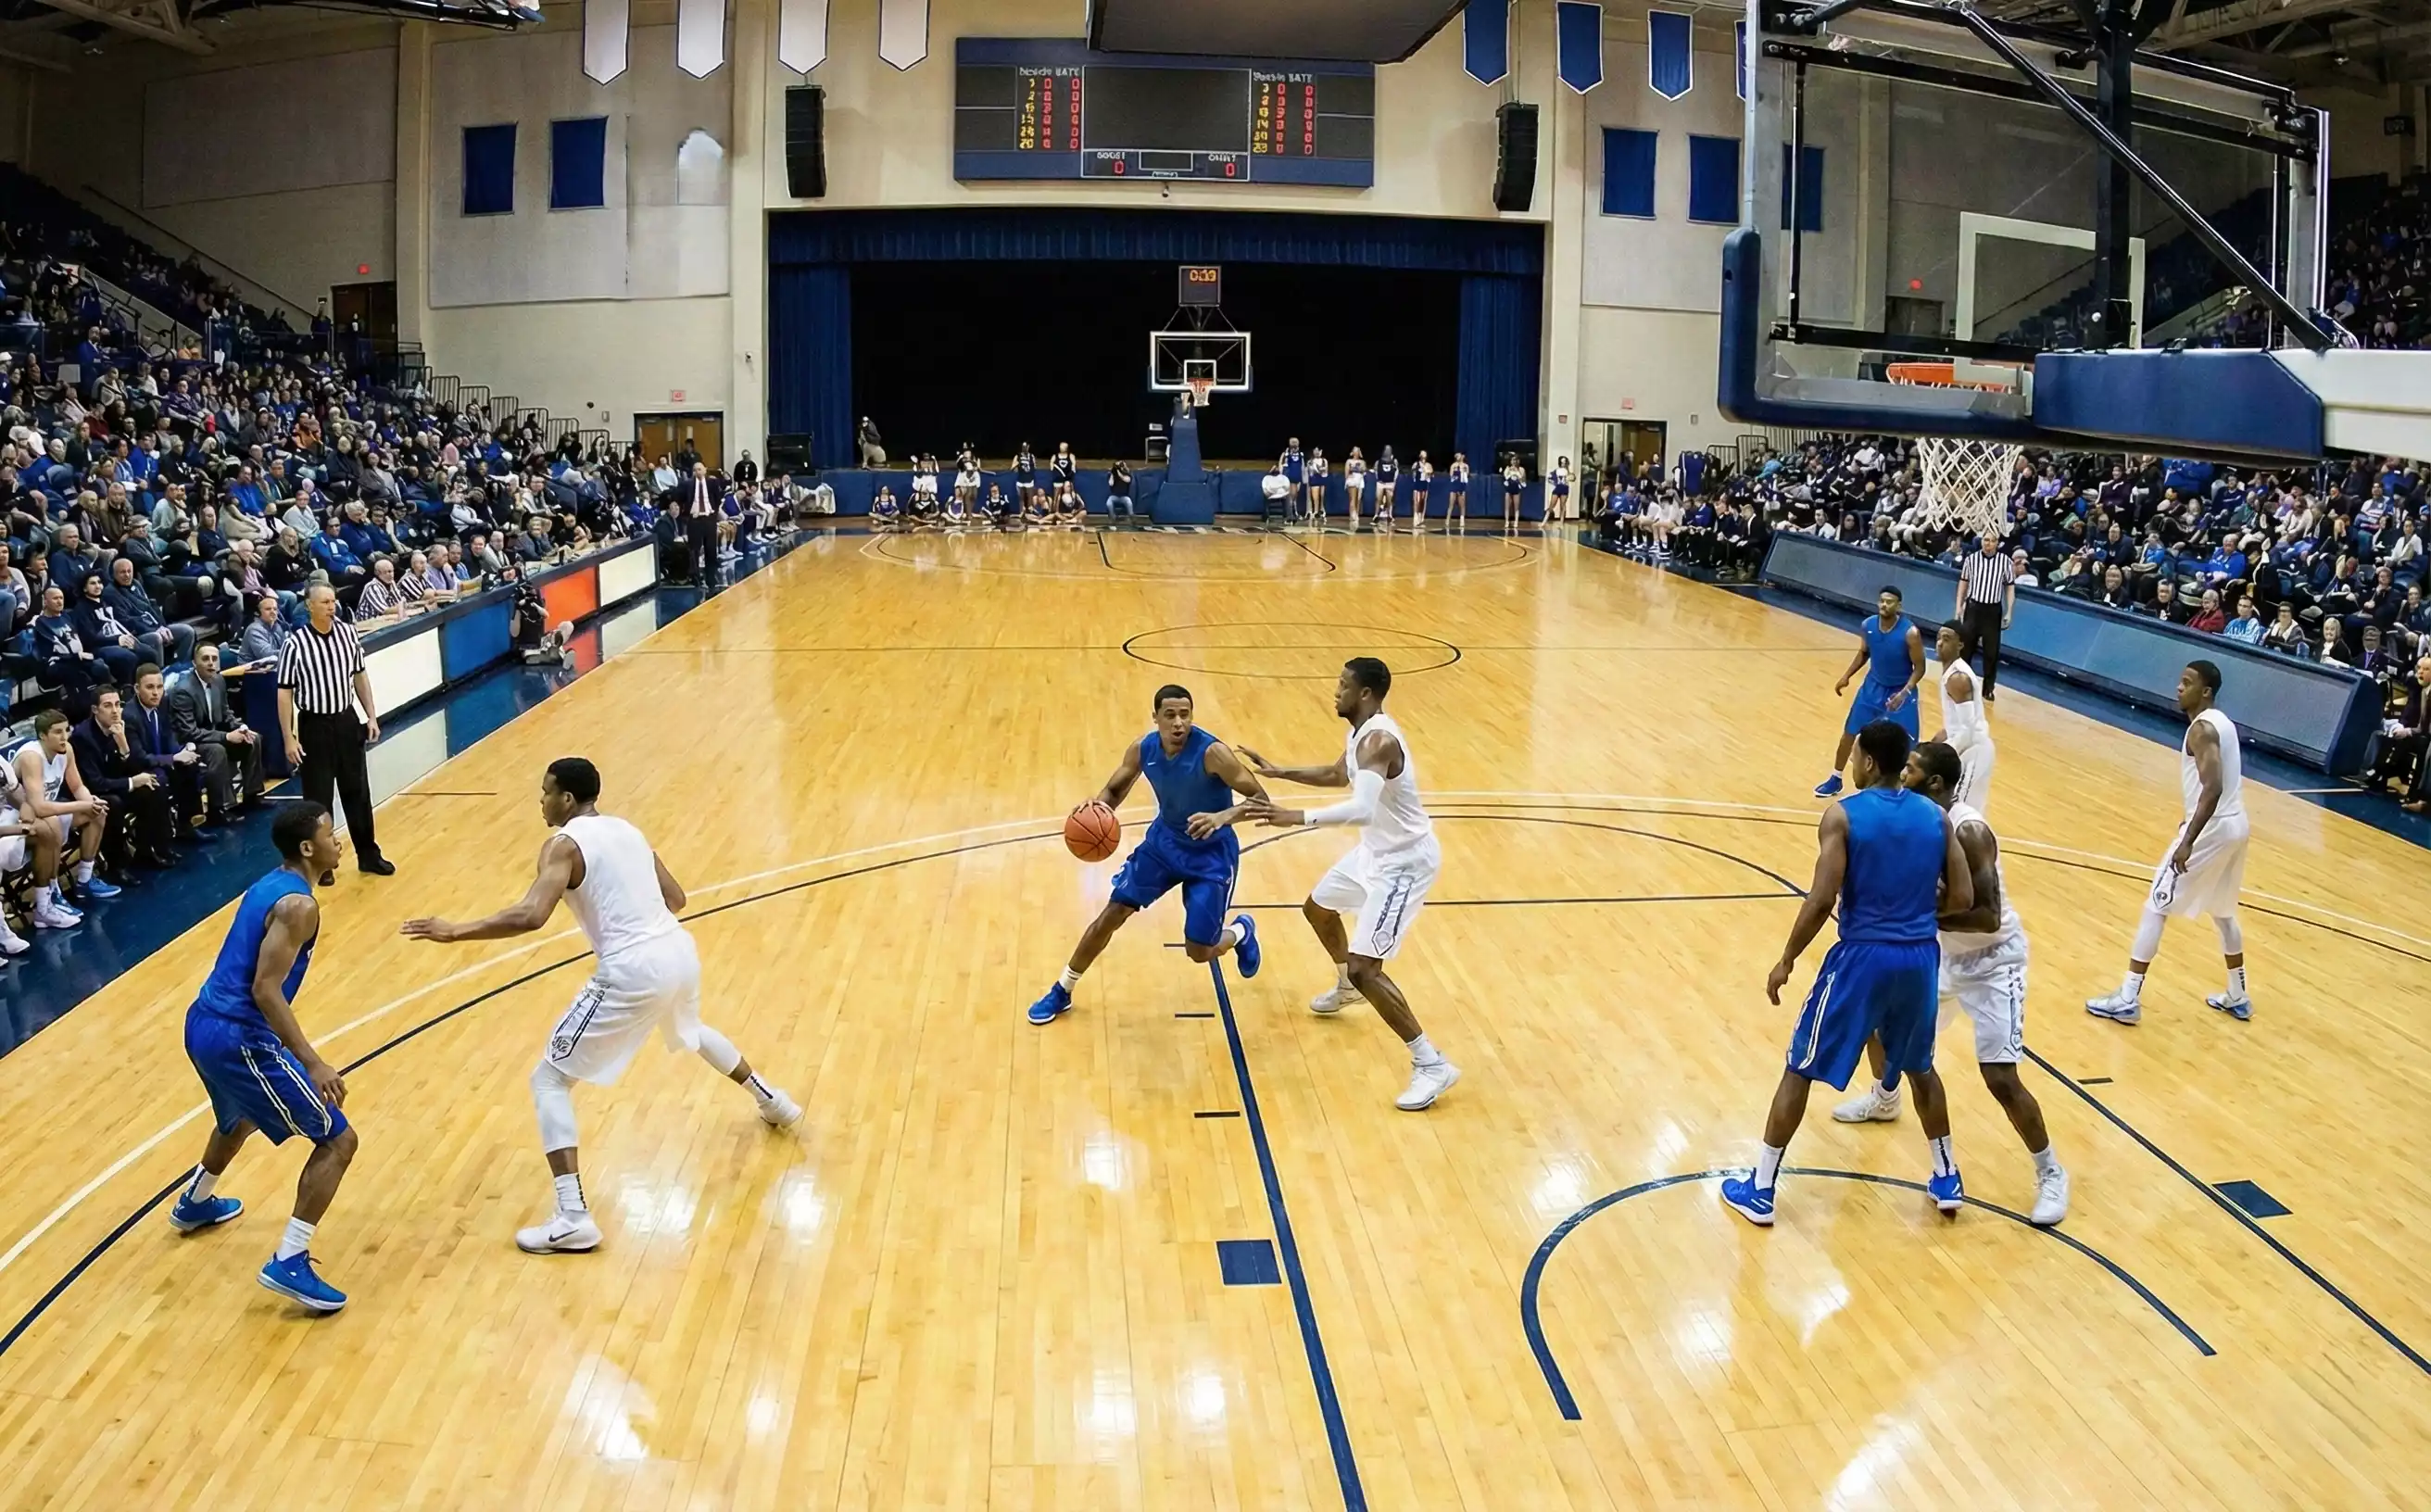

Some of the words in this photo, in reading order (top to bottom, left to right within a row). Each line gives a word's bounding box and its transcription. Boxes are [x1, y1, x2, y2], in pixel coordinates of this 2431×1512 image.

[1044, 78, 1052, 89] 0
[1071, 78, 1080, 89] 0
[1304, 144, 1313, 154] 0
[1115, 161, 1124, 174] 0
[1226, 163, 1235, 176] 0
